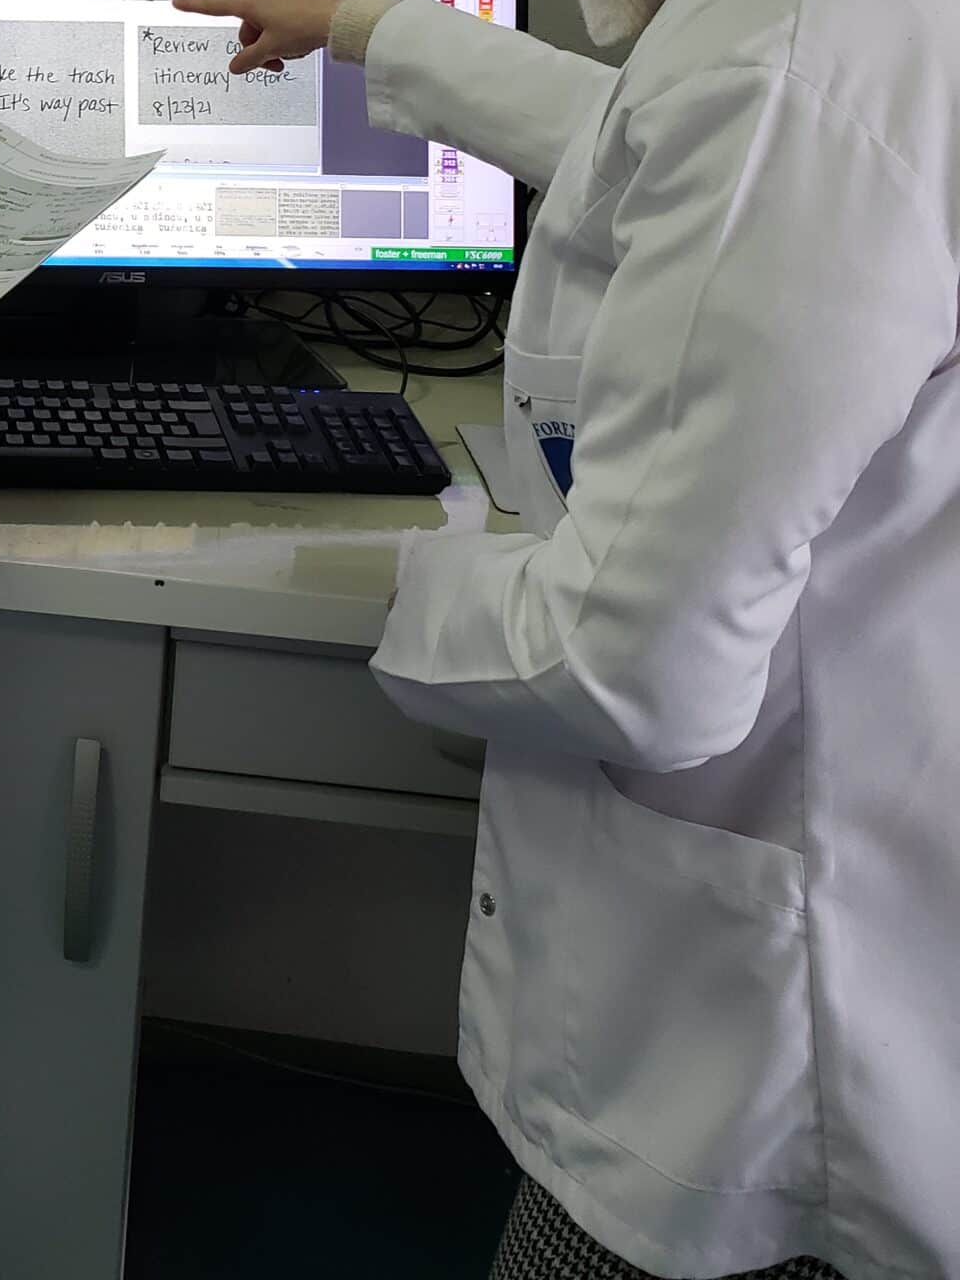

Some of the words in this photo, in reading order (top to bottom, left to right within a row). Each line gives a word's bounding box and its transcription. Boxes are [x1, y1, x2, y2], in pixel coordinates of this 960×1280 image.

[25, 66, 59, 84] the
[69, 67, 115, 85] trash
[153, 68, 230, 93] itinerary
[245, 72, 296, 87] before
[40, 97, 73, 122] way
[78, 98, 119, 119] past
[152, 96, 211, 121] 8/23/21
[375, 250, 401, 258] foster
[411, 250, 447, 259] freeman
[100, 272, 147, 283] ASUS
